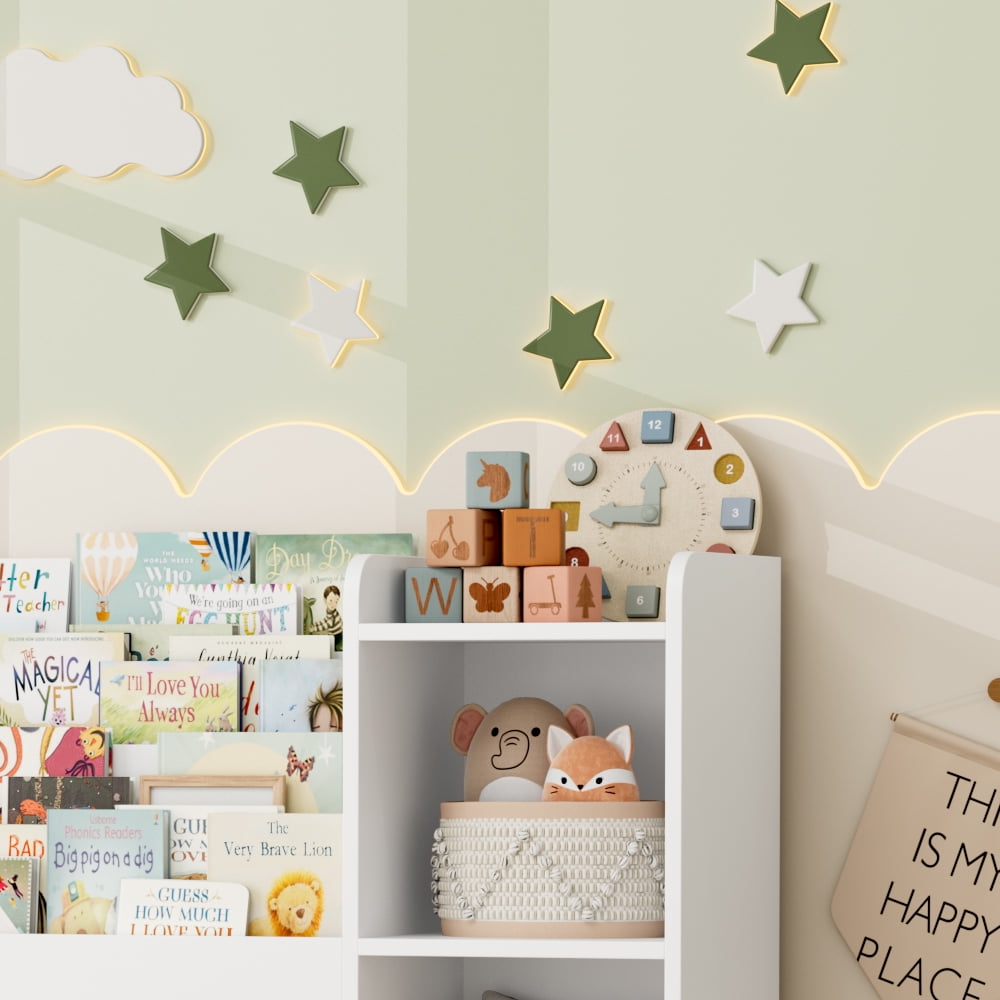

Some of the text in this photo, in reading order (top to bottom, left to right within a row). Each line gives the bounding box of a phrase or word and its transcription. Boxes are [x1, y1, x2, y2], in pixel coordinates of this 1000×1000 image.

[647, 420, 662, 430] 12
[607, 434, 620, 444] 11
[697, 437, 704, 447] 1
[572, 462, 586, 472] 10
[726, 464, 734, 475] 2
[732, 508, 740, 518] 3
[516, 516, 550, 559] T
[265, 542, 311, 582] Day
[145, 566, 192, 584] Who
[2, 592, 65, 614] Teacher
[189, 594, 274, 612] We're going on an
[411, 577, 458, 616] W
[636, 595, 644, 606] 6
[226, 605, 290, 635] HUNT
[21, 648, 36, 664] THE
[127, 671, 220, 698] I'll Love You
[37, 685, 78, 721] YET
[138, 700, 196, 729] Always
[946, 770, 1000, 827] THI
[65, 825, 143, 839] Phonics Readers
[266, 820, 289, 834] The
[8, 834, 45, 859] BAD
[224, 841, 254, 862] Very
[260, 841, 297, 856] Brave
[303, 842, 333, 857] Lion
[54, 841, 154, 874] Big pig on a dig
[912, 828, 1000, 892] IS MY
[158, 887, 209, 903] GUESS
[135, 905, 230, 922] HOW MUCH
[880, 881, 1000, 954] HAPPY
[144, 924, 188, 936] LOVE
